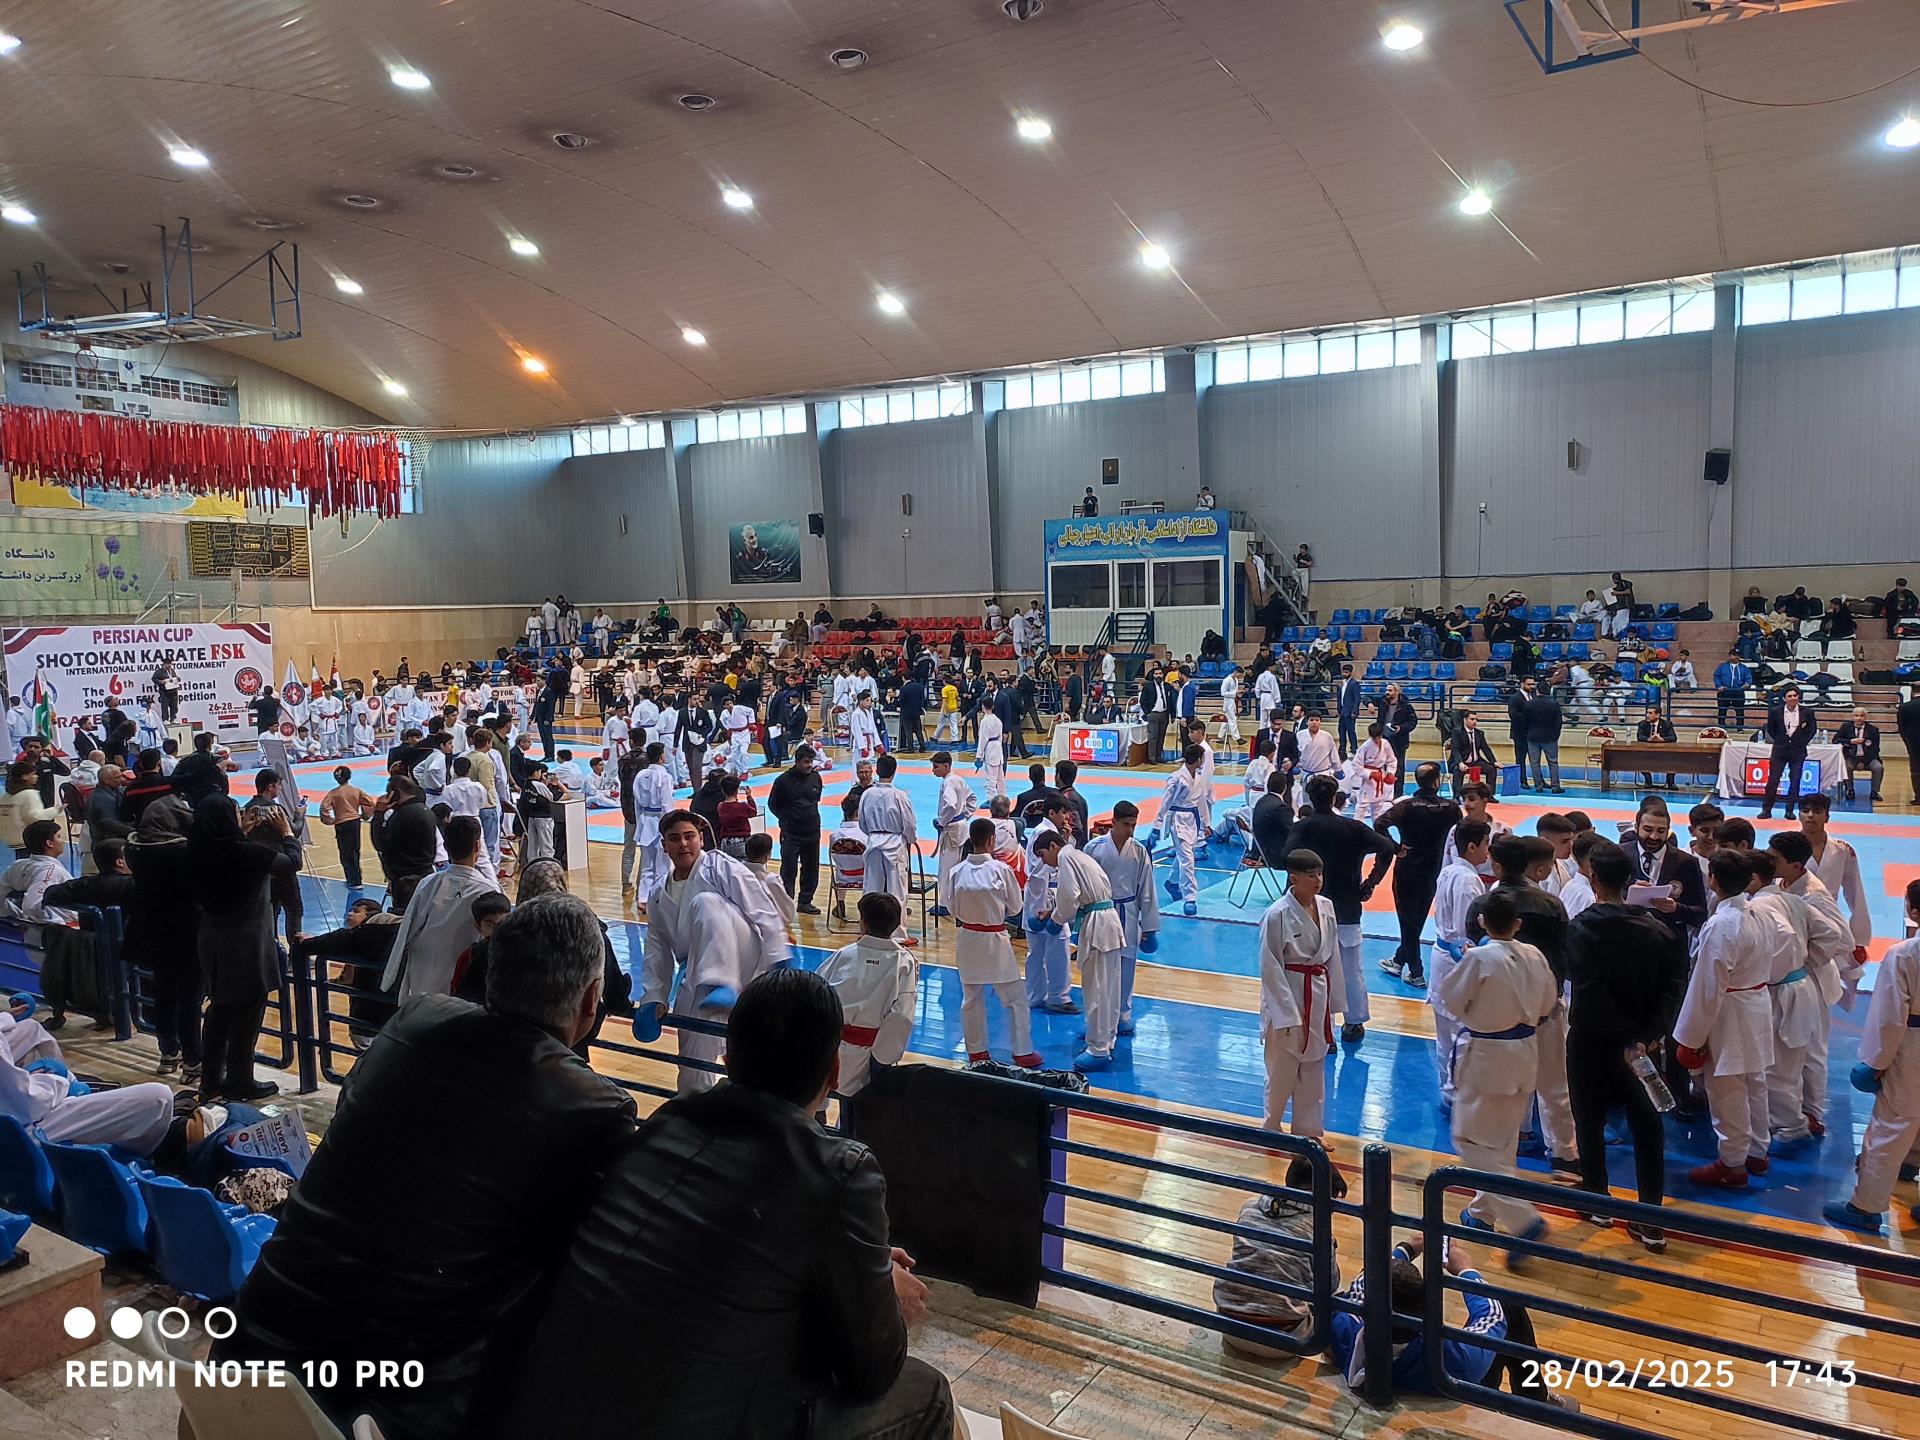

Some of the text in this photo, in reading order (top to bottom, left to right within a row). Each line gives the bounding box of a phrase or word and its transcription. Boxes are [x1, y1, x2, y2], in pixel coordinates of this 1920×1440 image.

[1172, 516, 1190, 542] آزاد
[1187, 516, 1218, 537] دانشگاه
[5, 547, 56, 559] دانشگاه
[93, 627, 194, 645] PERSIAN CUP
[36, 643, 246, 669] SHOTOKAN KARATE FSK
[66, 665, 136, 676] INTERNATIONAL
[173, 660, 227, 670] TOURNAMENT
[82, 674, 216, 697] The 6th intational
[84, 696, 134, 709] Shokan
[1074, 737, 1081, 749] 0
[1106, 739, 1113, 750] 0
[1752, 767, 1812, 783] 0 0
[274, 1120, 290, 1154] KARATE
